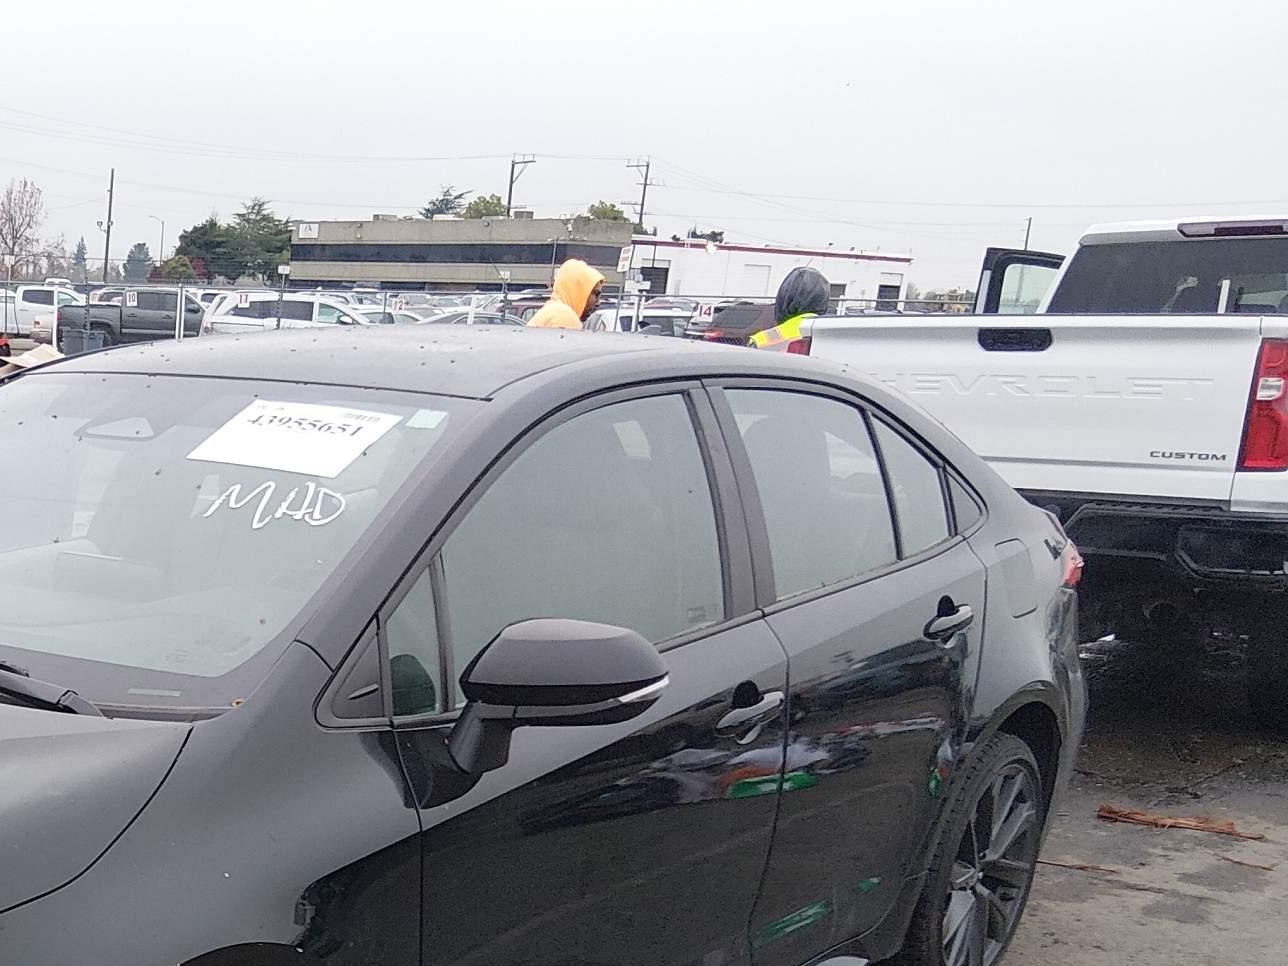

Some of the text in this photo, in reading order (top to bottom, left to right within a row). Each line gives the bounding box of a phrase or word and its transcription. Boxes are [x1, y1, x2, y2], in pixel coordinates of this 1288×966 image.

[127, 294, 136, 304] 10
[239, 294, 248, 304] 11
[699, 304, 712, 317] 14
[1150, 451, 1227, 462] CUSTOM
